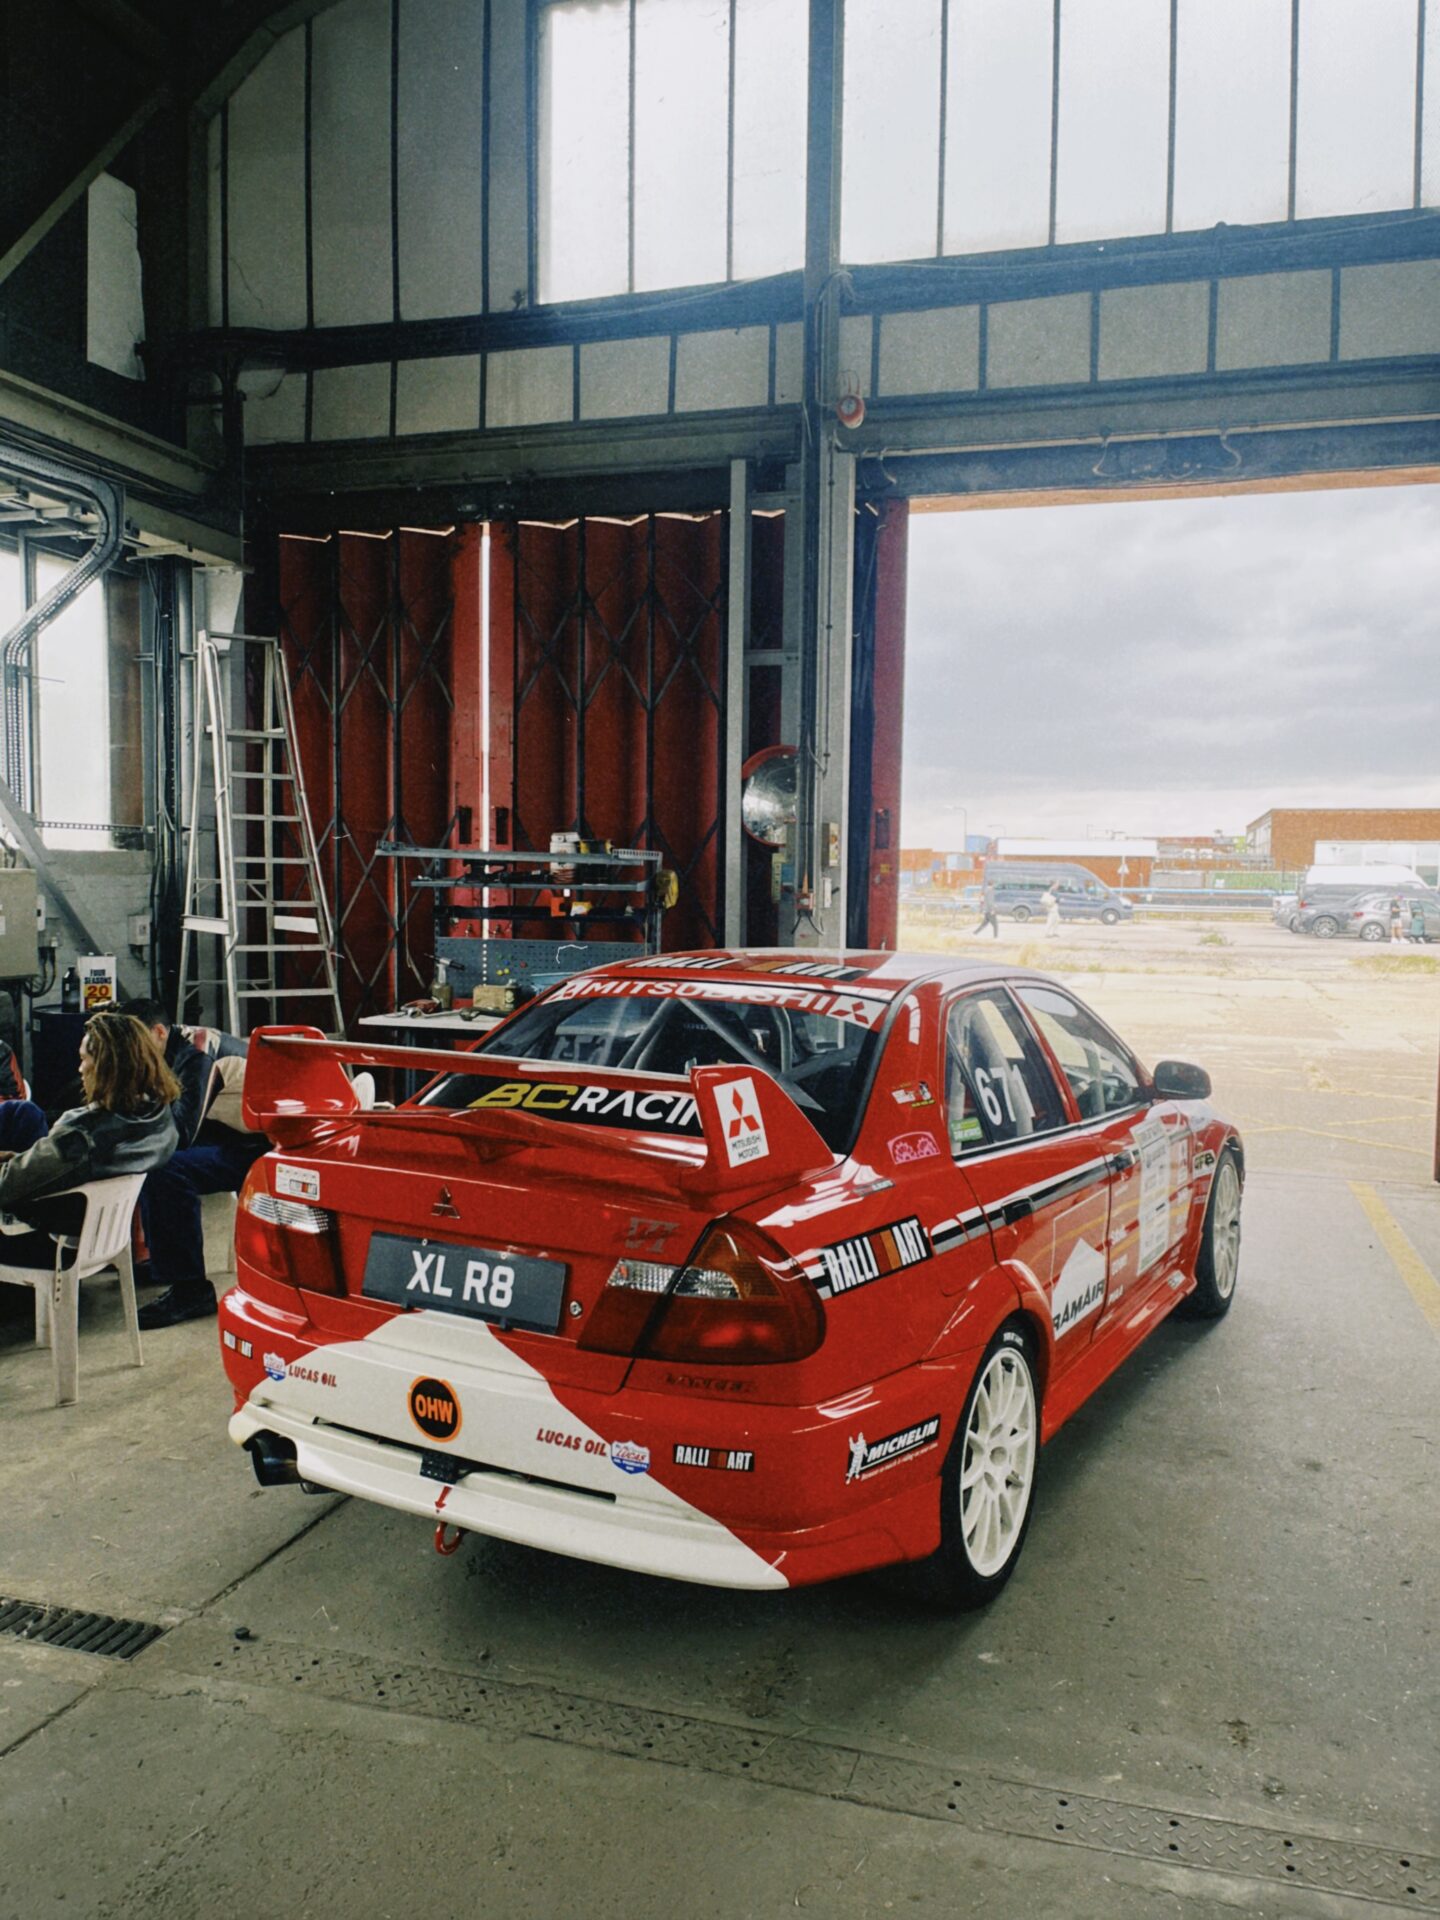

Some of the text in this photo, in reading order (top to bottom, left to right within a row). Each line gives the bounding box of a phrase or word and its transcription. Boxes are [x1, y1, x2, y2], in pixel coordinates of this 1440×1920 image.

[771, 962, 871, 980] ART
[87, 985, 110, 998] 20
[975, 1064, 1036, 1126] 671
[823, 1219, 928, 1293] RALLI ART
[406, 1250, 515, 1309] XL R8
[288, 1365, 320, 1384] LUCAS
[321, 1372, 338, 1388] OIL
[415, 1393, 453, 1425] OHW
[536, 1427, 608, 1458] LUCAS OIL
[867, 1419, 939, 1463] MICHELIN
[675, 1445, 753, 1471] RALLI ART
